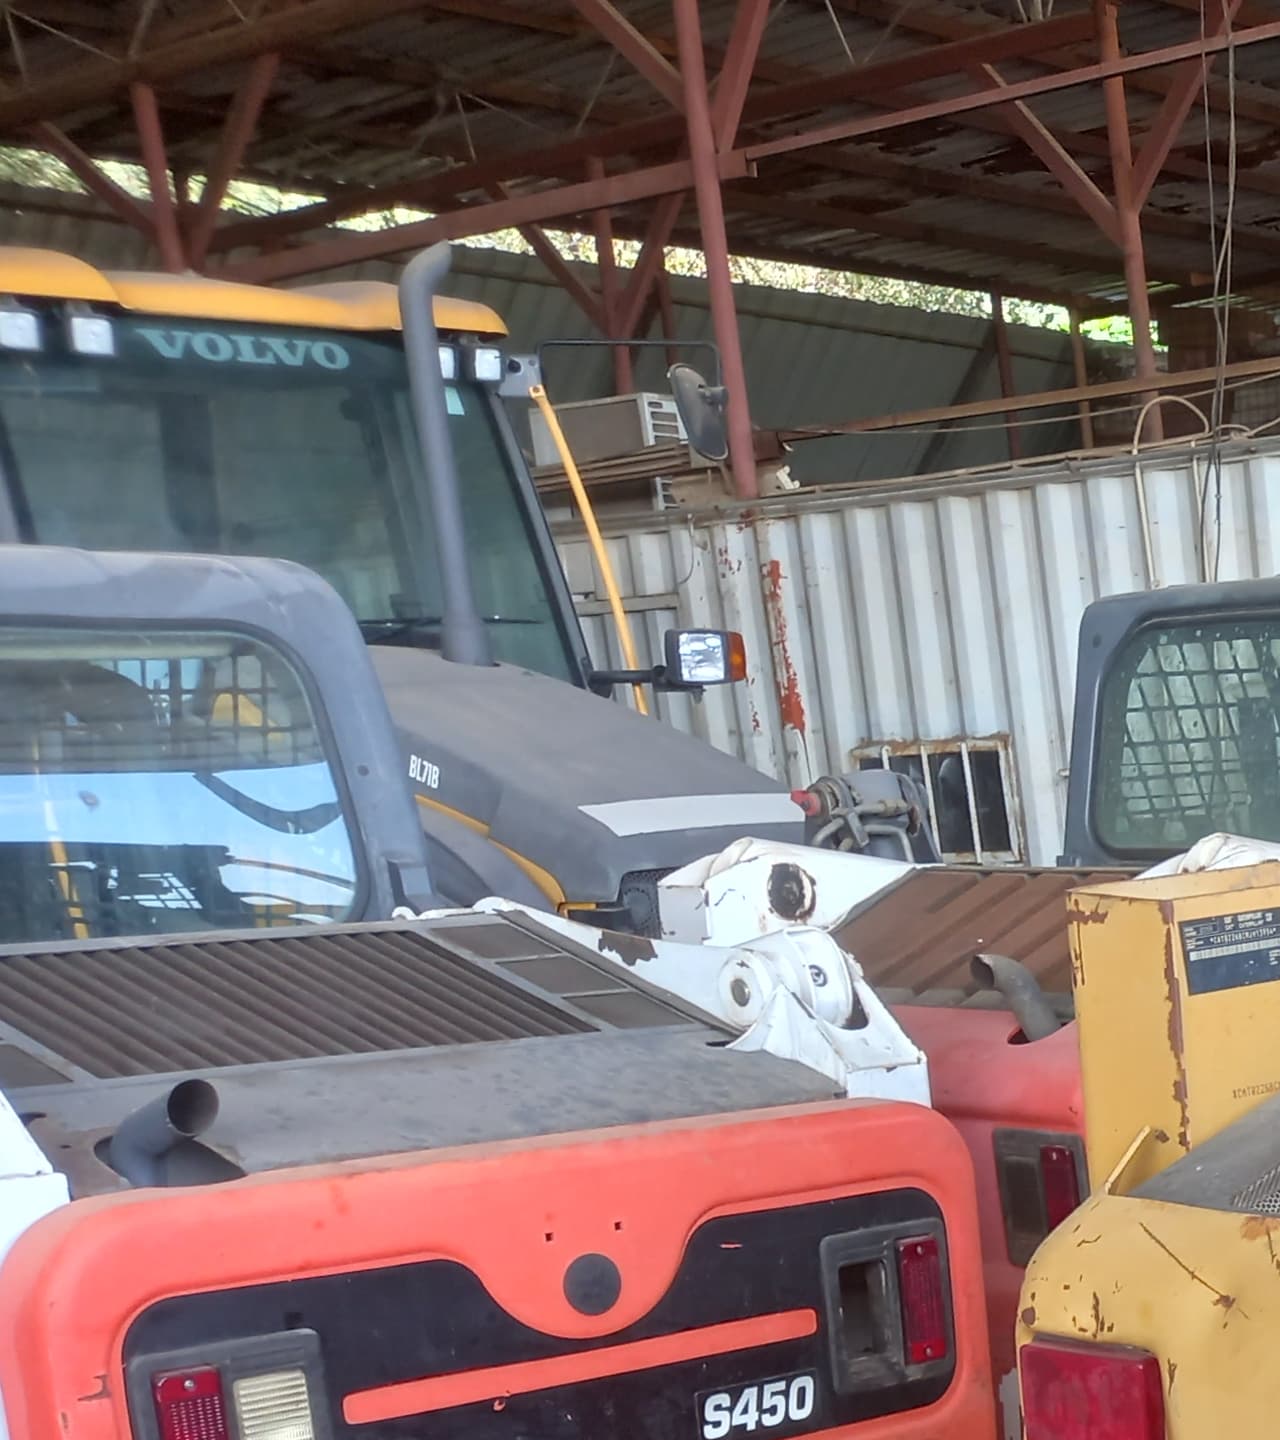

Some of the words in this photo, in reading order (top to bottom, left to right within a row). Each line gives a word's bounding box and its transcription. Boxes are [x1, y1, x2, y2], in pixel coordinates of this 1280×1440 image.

[134, 327, 350, 370] VOLVO
[408, 754, 440, 789] BL71B
[703, 1375, 815, 1440] S450
